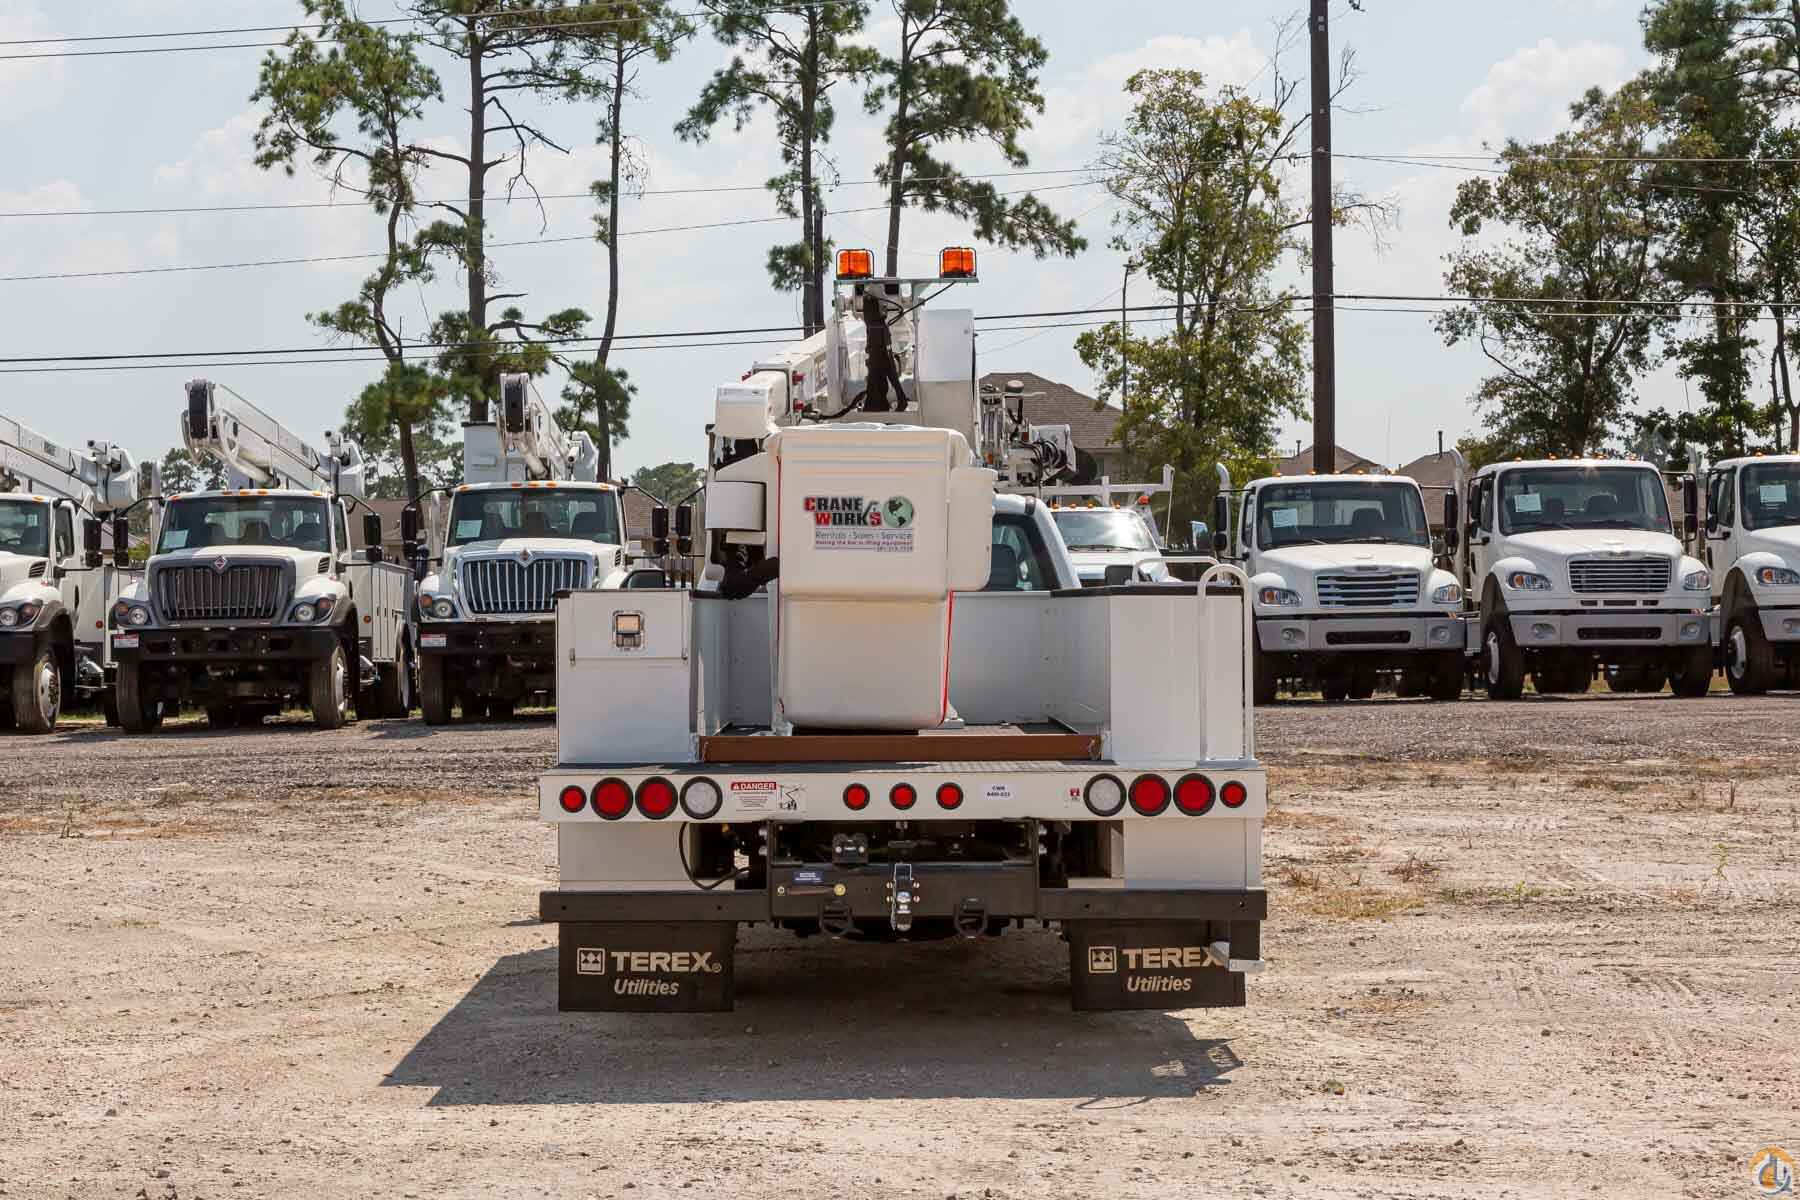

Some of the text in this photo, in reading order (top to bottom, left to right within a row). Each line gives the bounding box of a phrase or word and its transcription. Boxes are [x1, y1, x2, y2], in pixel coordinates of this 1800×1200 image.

[804, 497, 863, 511] CRANE
[815, 511, 882, 526] WORKS
[882, 531, 913, 540] Service
[1122, 947, 1225, 968] TEREX
[614, 978, 680, 995] Utilities
[1127, 976, 1192, 992] Utilities
